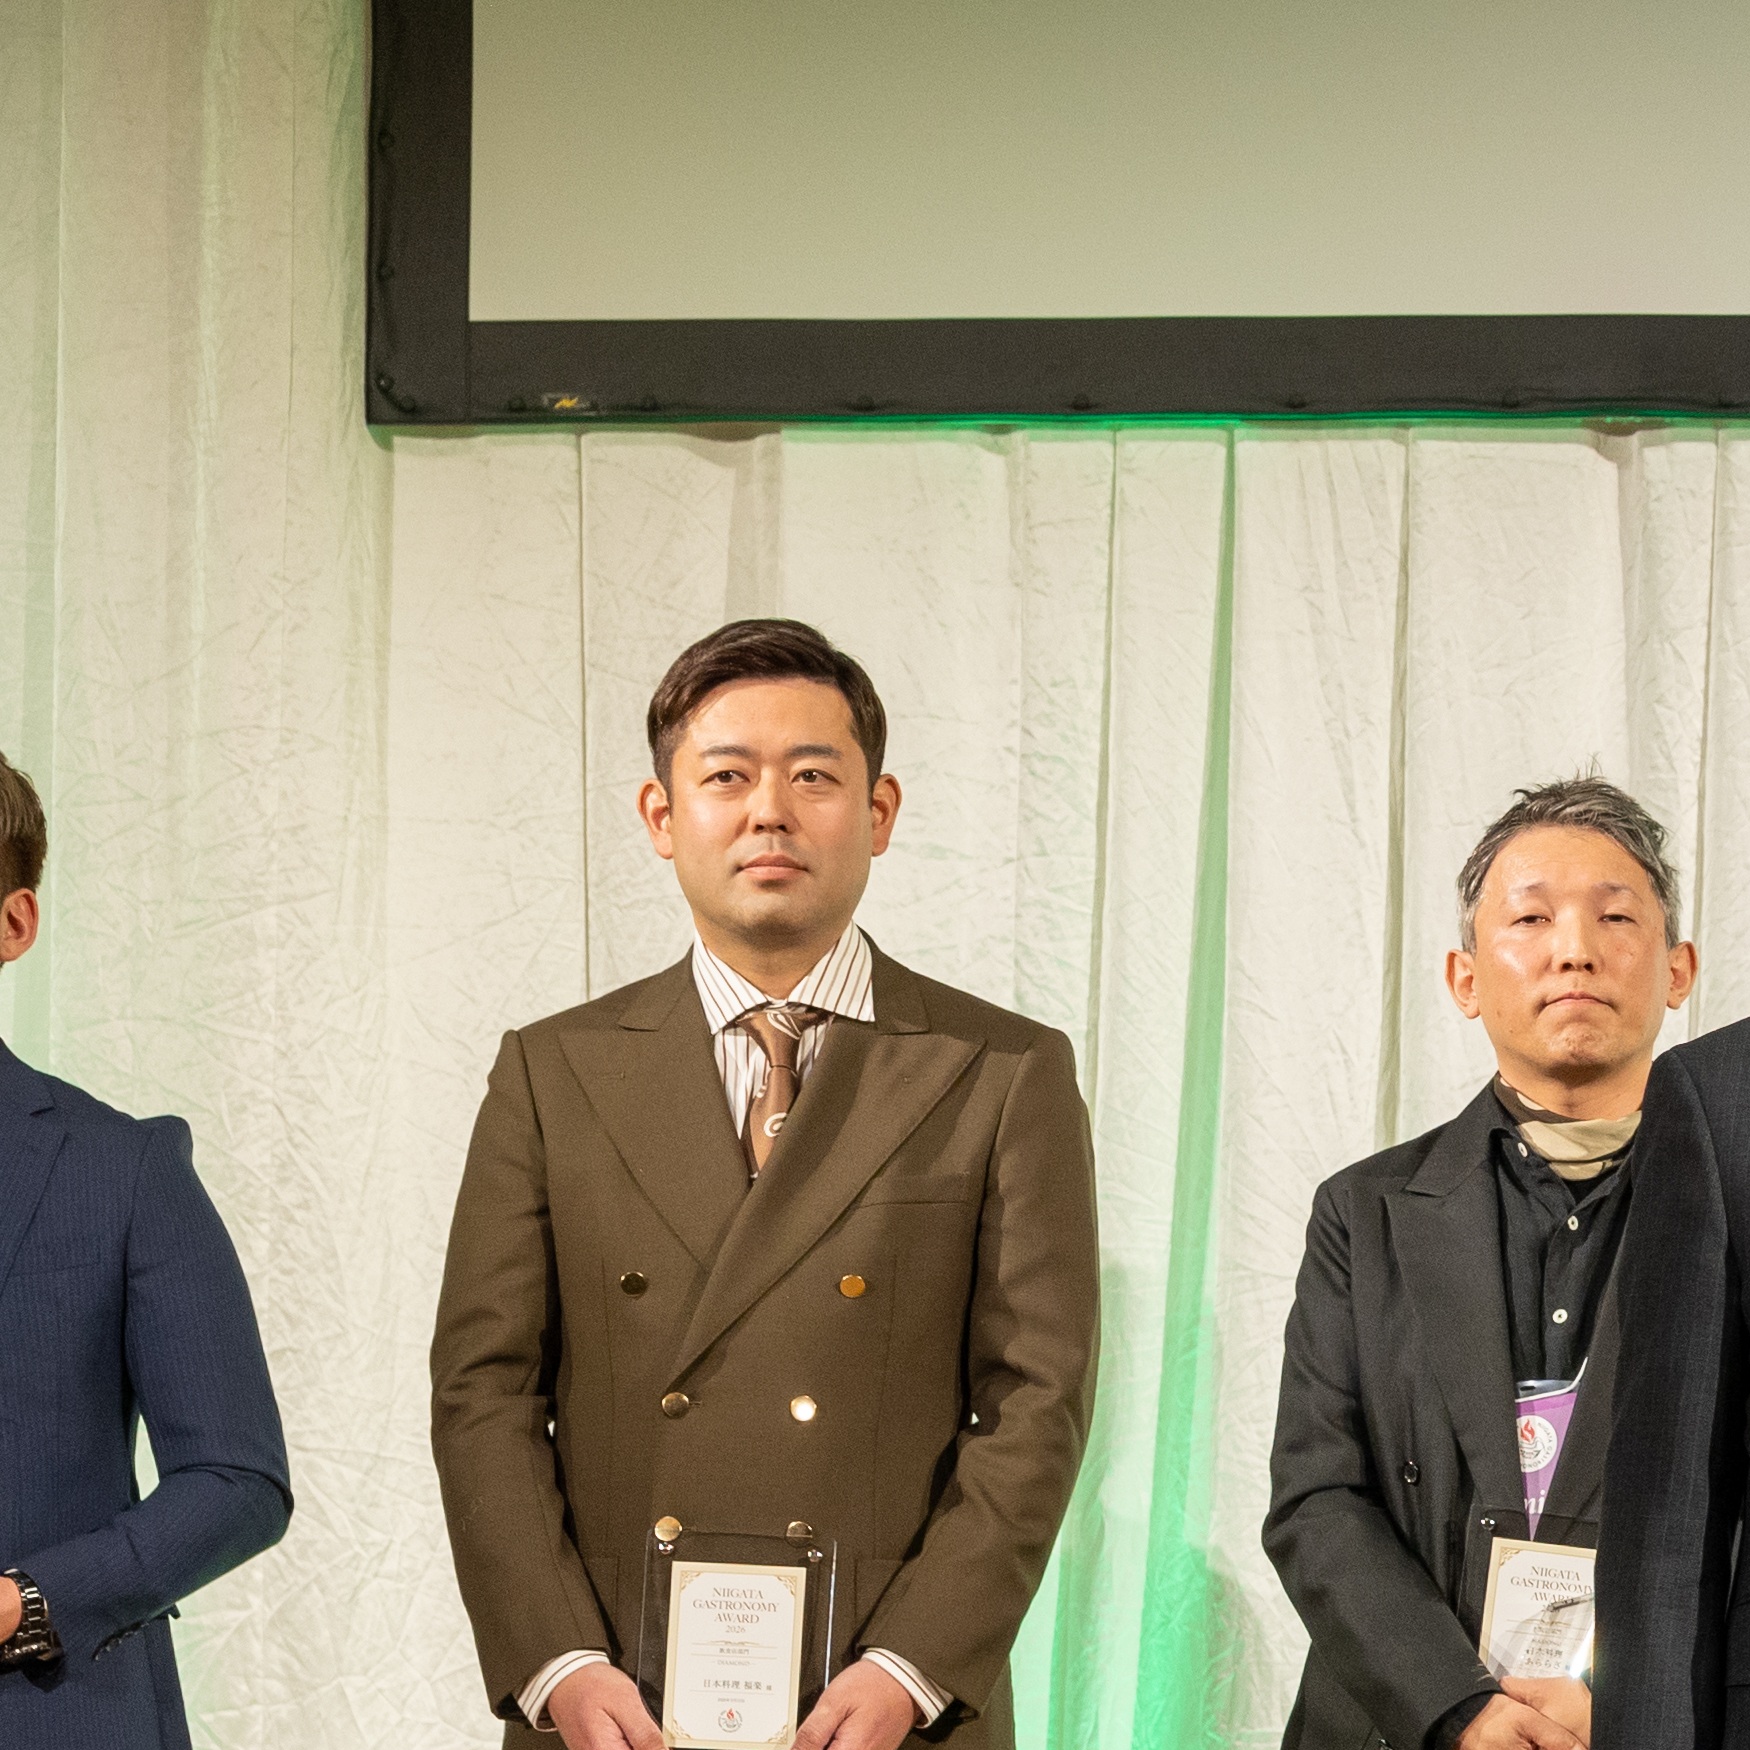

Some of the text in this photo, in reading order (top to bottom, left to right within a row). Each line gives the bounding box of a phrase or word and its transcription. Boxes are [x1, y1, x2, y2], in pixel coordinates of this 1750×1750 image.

[1530, 1565, 1581, 1581] NIIGATA
[712, 1587, 764, 1600] NIIGATA
[692, 1599, 780, 1613] GASTRONOMY
[714, 1612, 760, 1624] AWARD
